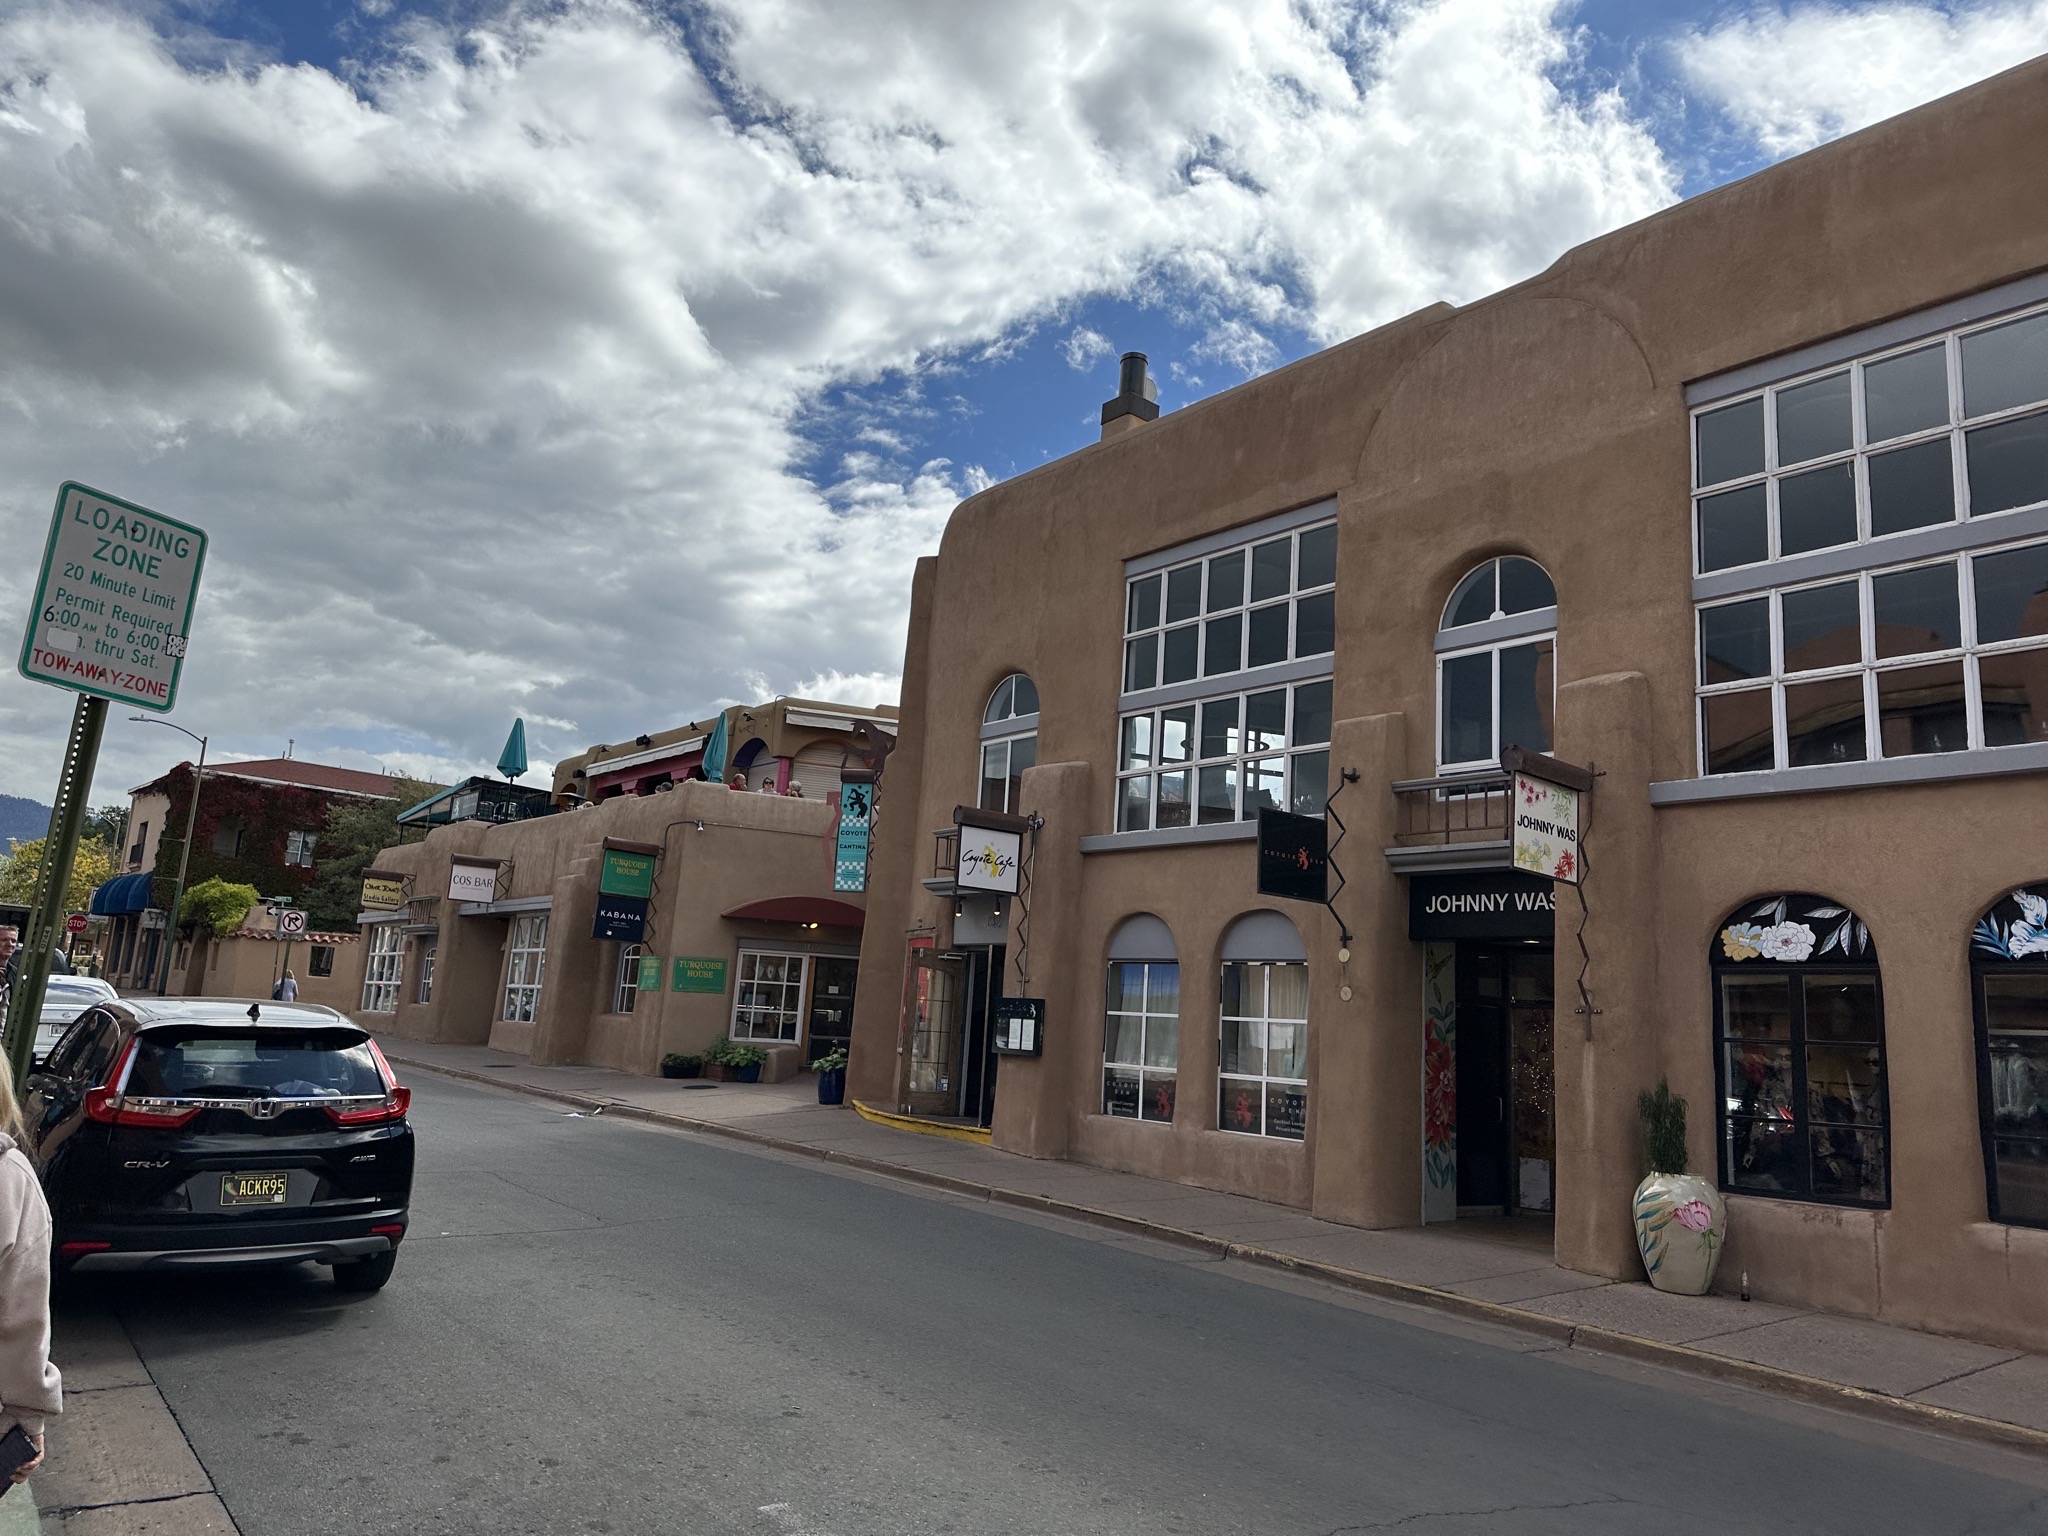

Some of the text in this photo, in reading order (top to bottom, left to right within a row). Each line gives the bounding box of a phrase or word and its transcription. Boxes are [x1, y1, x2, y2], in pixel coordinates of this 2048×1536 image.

[74, 500, 190, 559] LOADING
[92, 537, 162, 579] ZONE
[63, 562, 176, 611] 20 Minute Limit
[55, 587, 173, 636] Permit Required
[43, 605, 80, 627] 6:00
[82, 623, 97, 633] AM
[105, 623, 118, 639] to
[126, 630, 160, 651] 6:00
[95, 638, 124, 659] thru
[131, 649, 158, 669] Sat.
[1517, 814, 1576, 842] JOHNNY WAS
[1264, 849, 1296, 860] COYOTE
[610, 857, 648, 869] TURQUOISE
[962, 849, 1016, 877] Coyote Cafe
[616, 867, 640, 876] HOUSE
[452, 874, 493, 888] COS BAR
[1425, 893, 1509, 914] JOHNNY
[600, 910, 641, 921] KABANA
[68, 919, 87, 928] STOP
[679, 960, 723, 970] TURQUOISE
[687, 970, 714, 979] HOUSE
[1269, 1097, 1305, 1107] COYOT
[123, 1160, 171, 1169] CR-V
[239, 1179, 285, 1196] ACKR95
